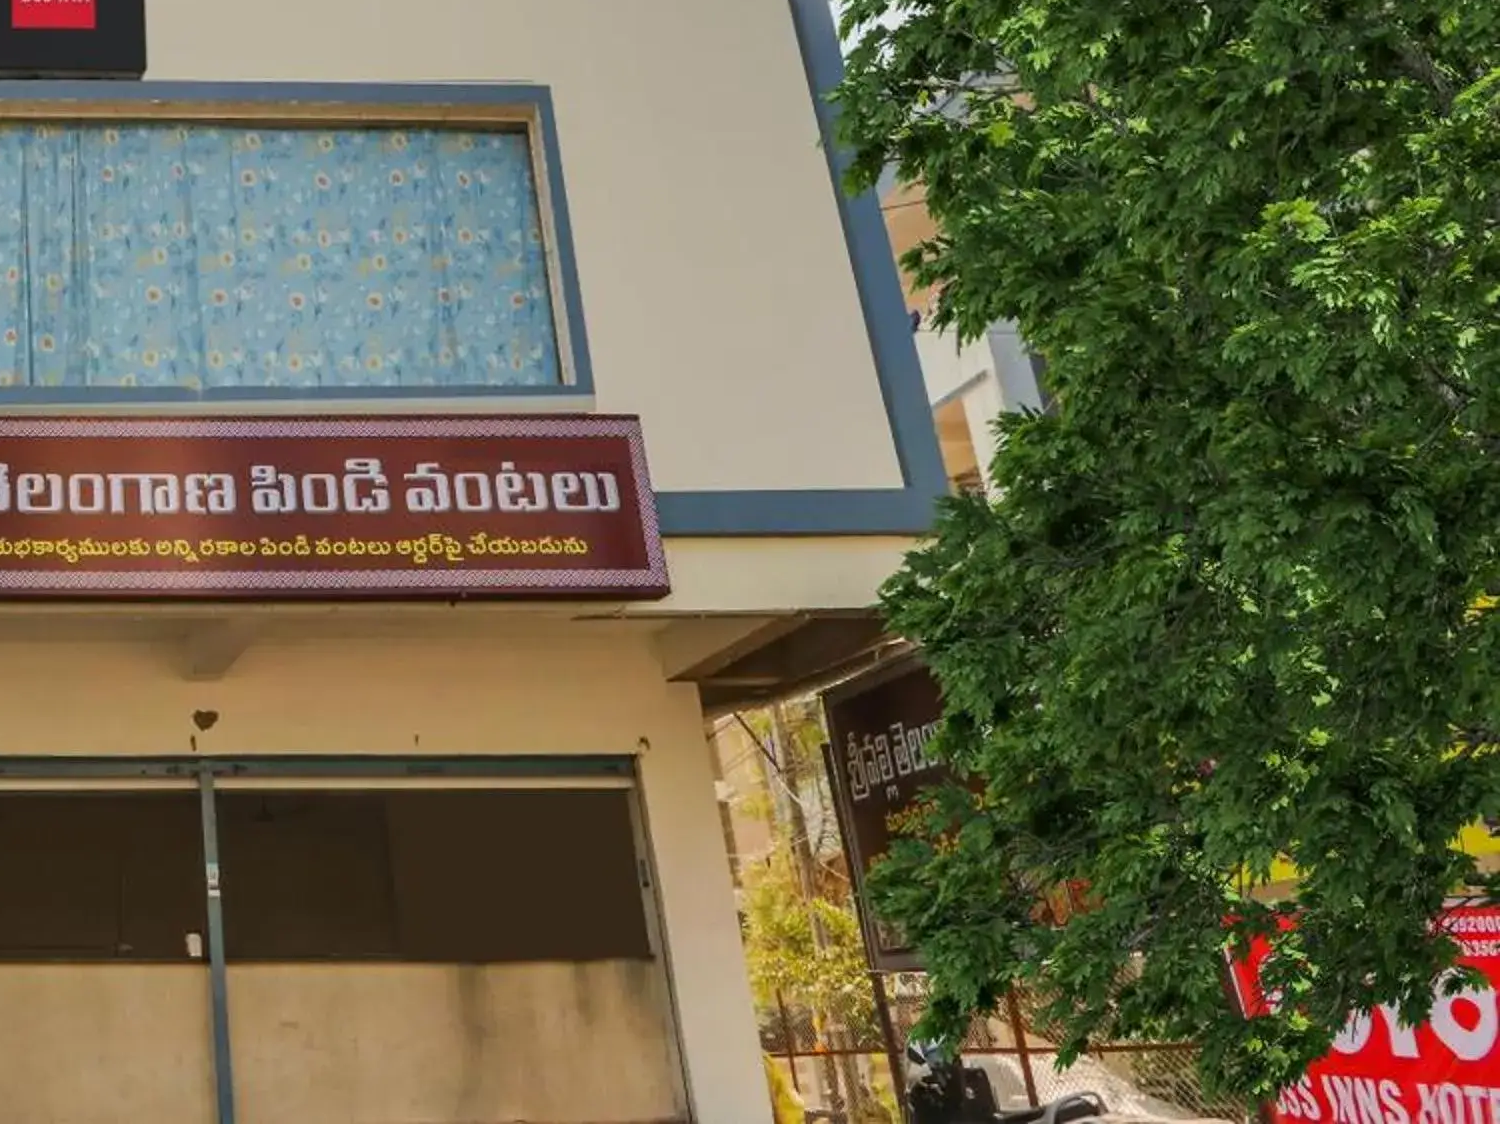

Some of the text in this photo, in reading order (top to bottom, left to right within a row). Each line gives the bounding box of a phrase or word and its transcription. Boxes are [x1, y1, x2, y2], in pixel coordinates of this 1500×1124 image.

[251, 458, 391, 514] పిండి
[404, 461, 620, 514] వంటలు
[261, 534, 311, 556] పిండి
[315, 536, 390, 556] వంటలు
